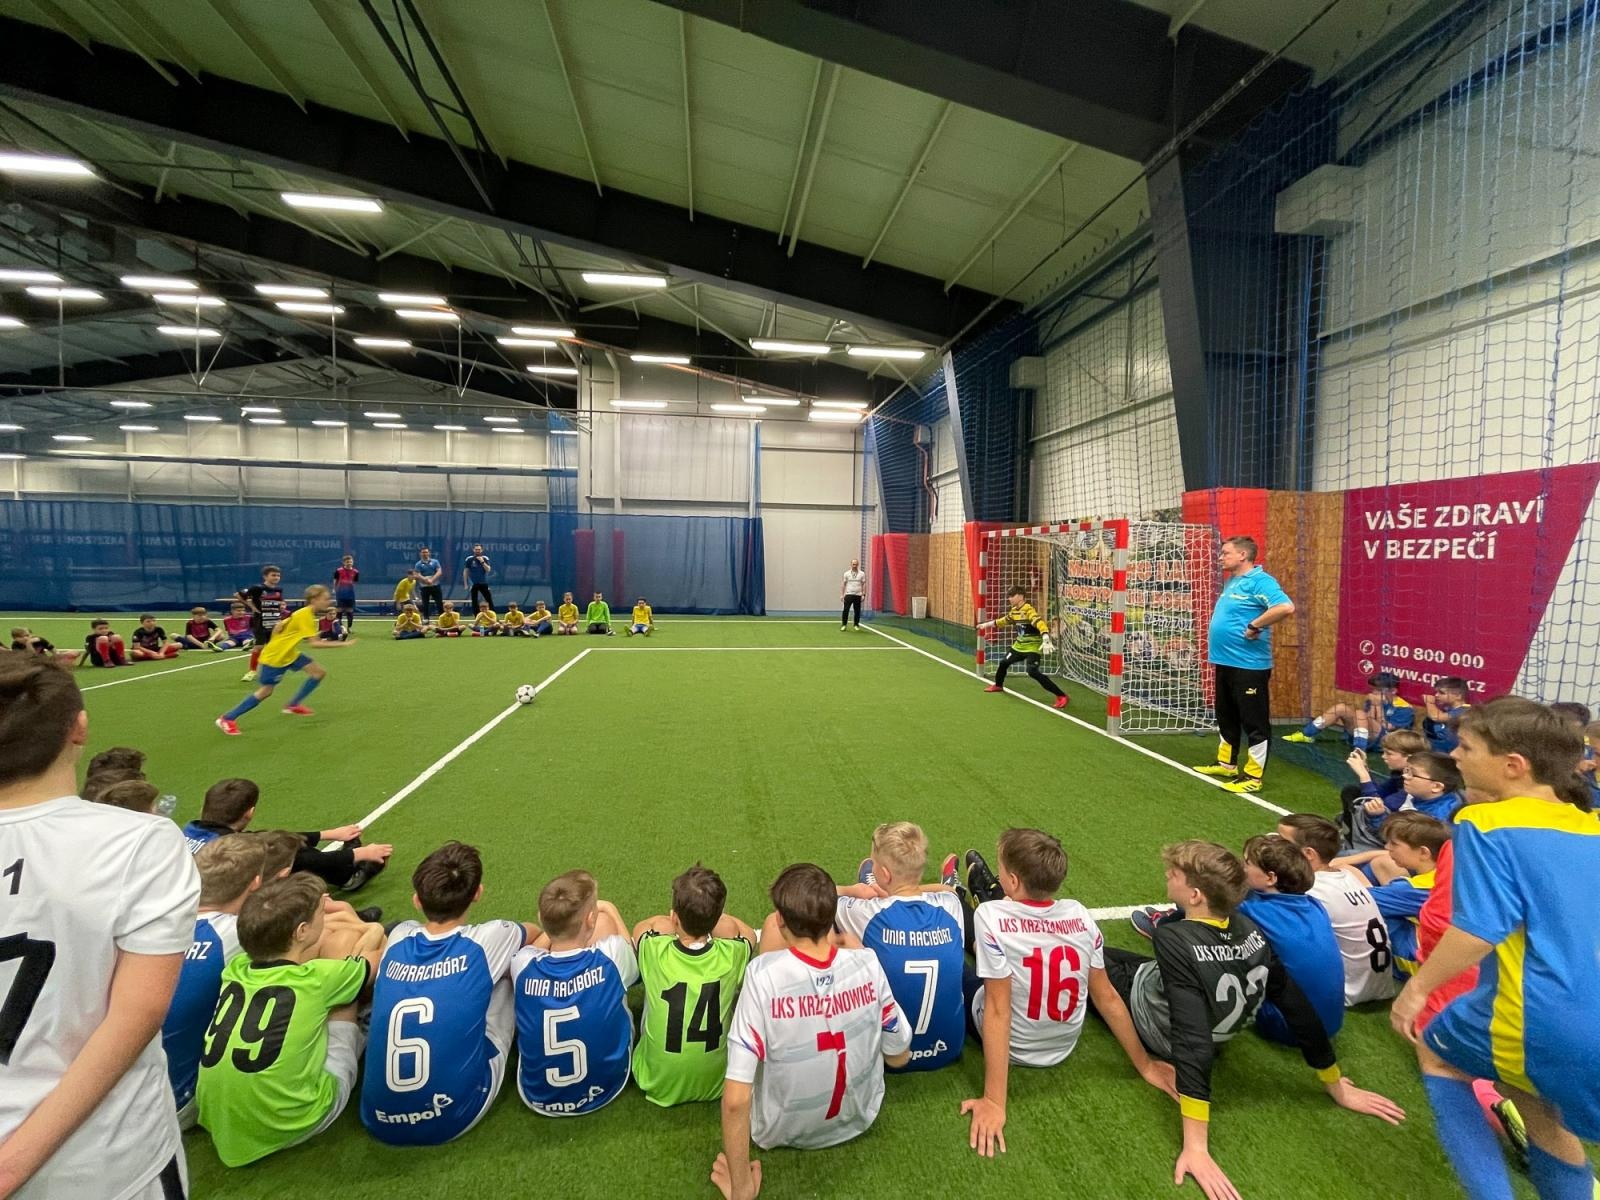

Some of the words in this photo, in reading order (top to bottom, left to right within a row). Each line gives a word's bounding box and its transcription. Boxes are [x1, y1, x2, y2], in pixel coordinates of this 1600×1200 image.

[1365, 503, 1427, 530] VAŠE
[1434, 494, 1546, 527] ZDRAVÍ
[251, 538, 341, 549] AQUACETRUM
[1363, 540, 1380, 559] V
[1386, 531, 1498, 560] BEZPEČÍ
[1382, 643, 1409, 659] 810
[1413, 647, 1445, 664] 800
[1450, 652, 1484, 669] 000
[1380, 665, 1486, 693] www.cpcz
[1344, 890, 1370, 906] U11
[882, 928, 906, 945] UNIA
[998, 918, 1018, 933] LKS
[1366, 917, 1391, 973] 8
[525, 978, 550, 996] UNIA
[553, 966, 606, 997] RACIBÓRZ
[904, 959, 939, 1035] 7
[1023, 946, 1080, 1023] 16
[661, 980, 723, 1054] 14
[771, 994, 795, 1019] LKS
[201, 981, 297, 1073] 99
[385, 997, 434, 1093] 6
[543, 1005, 588, 1087] 5
[816, 1031, 846, 1120] 7
